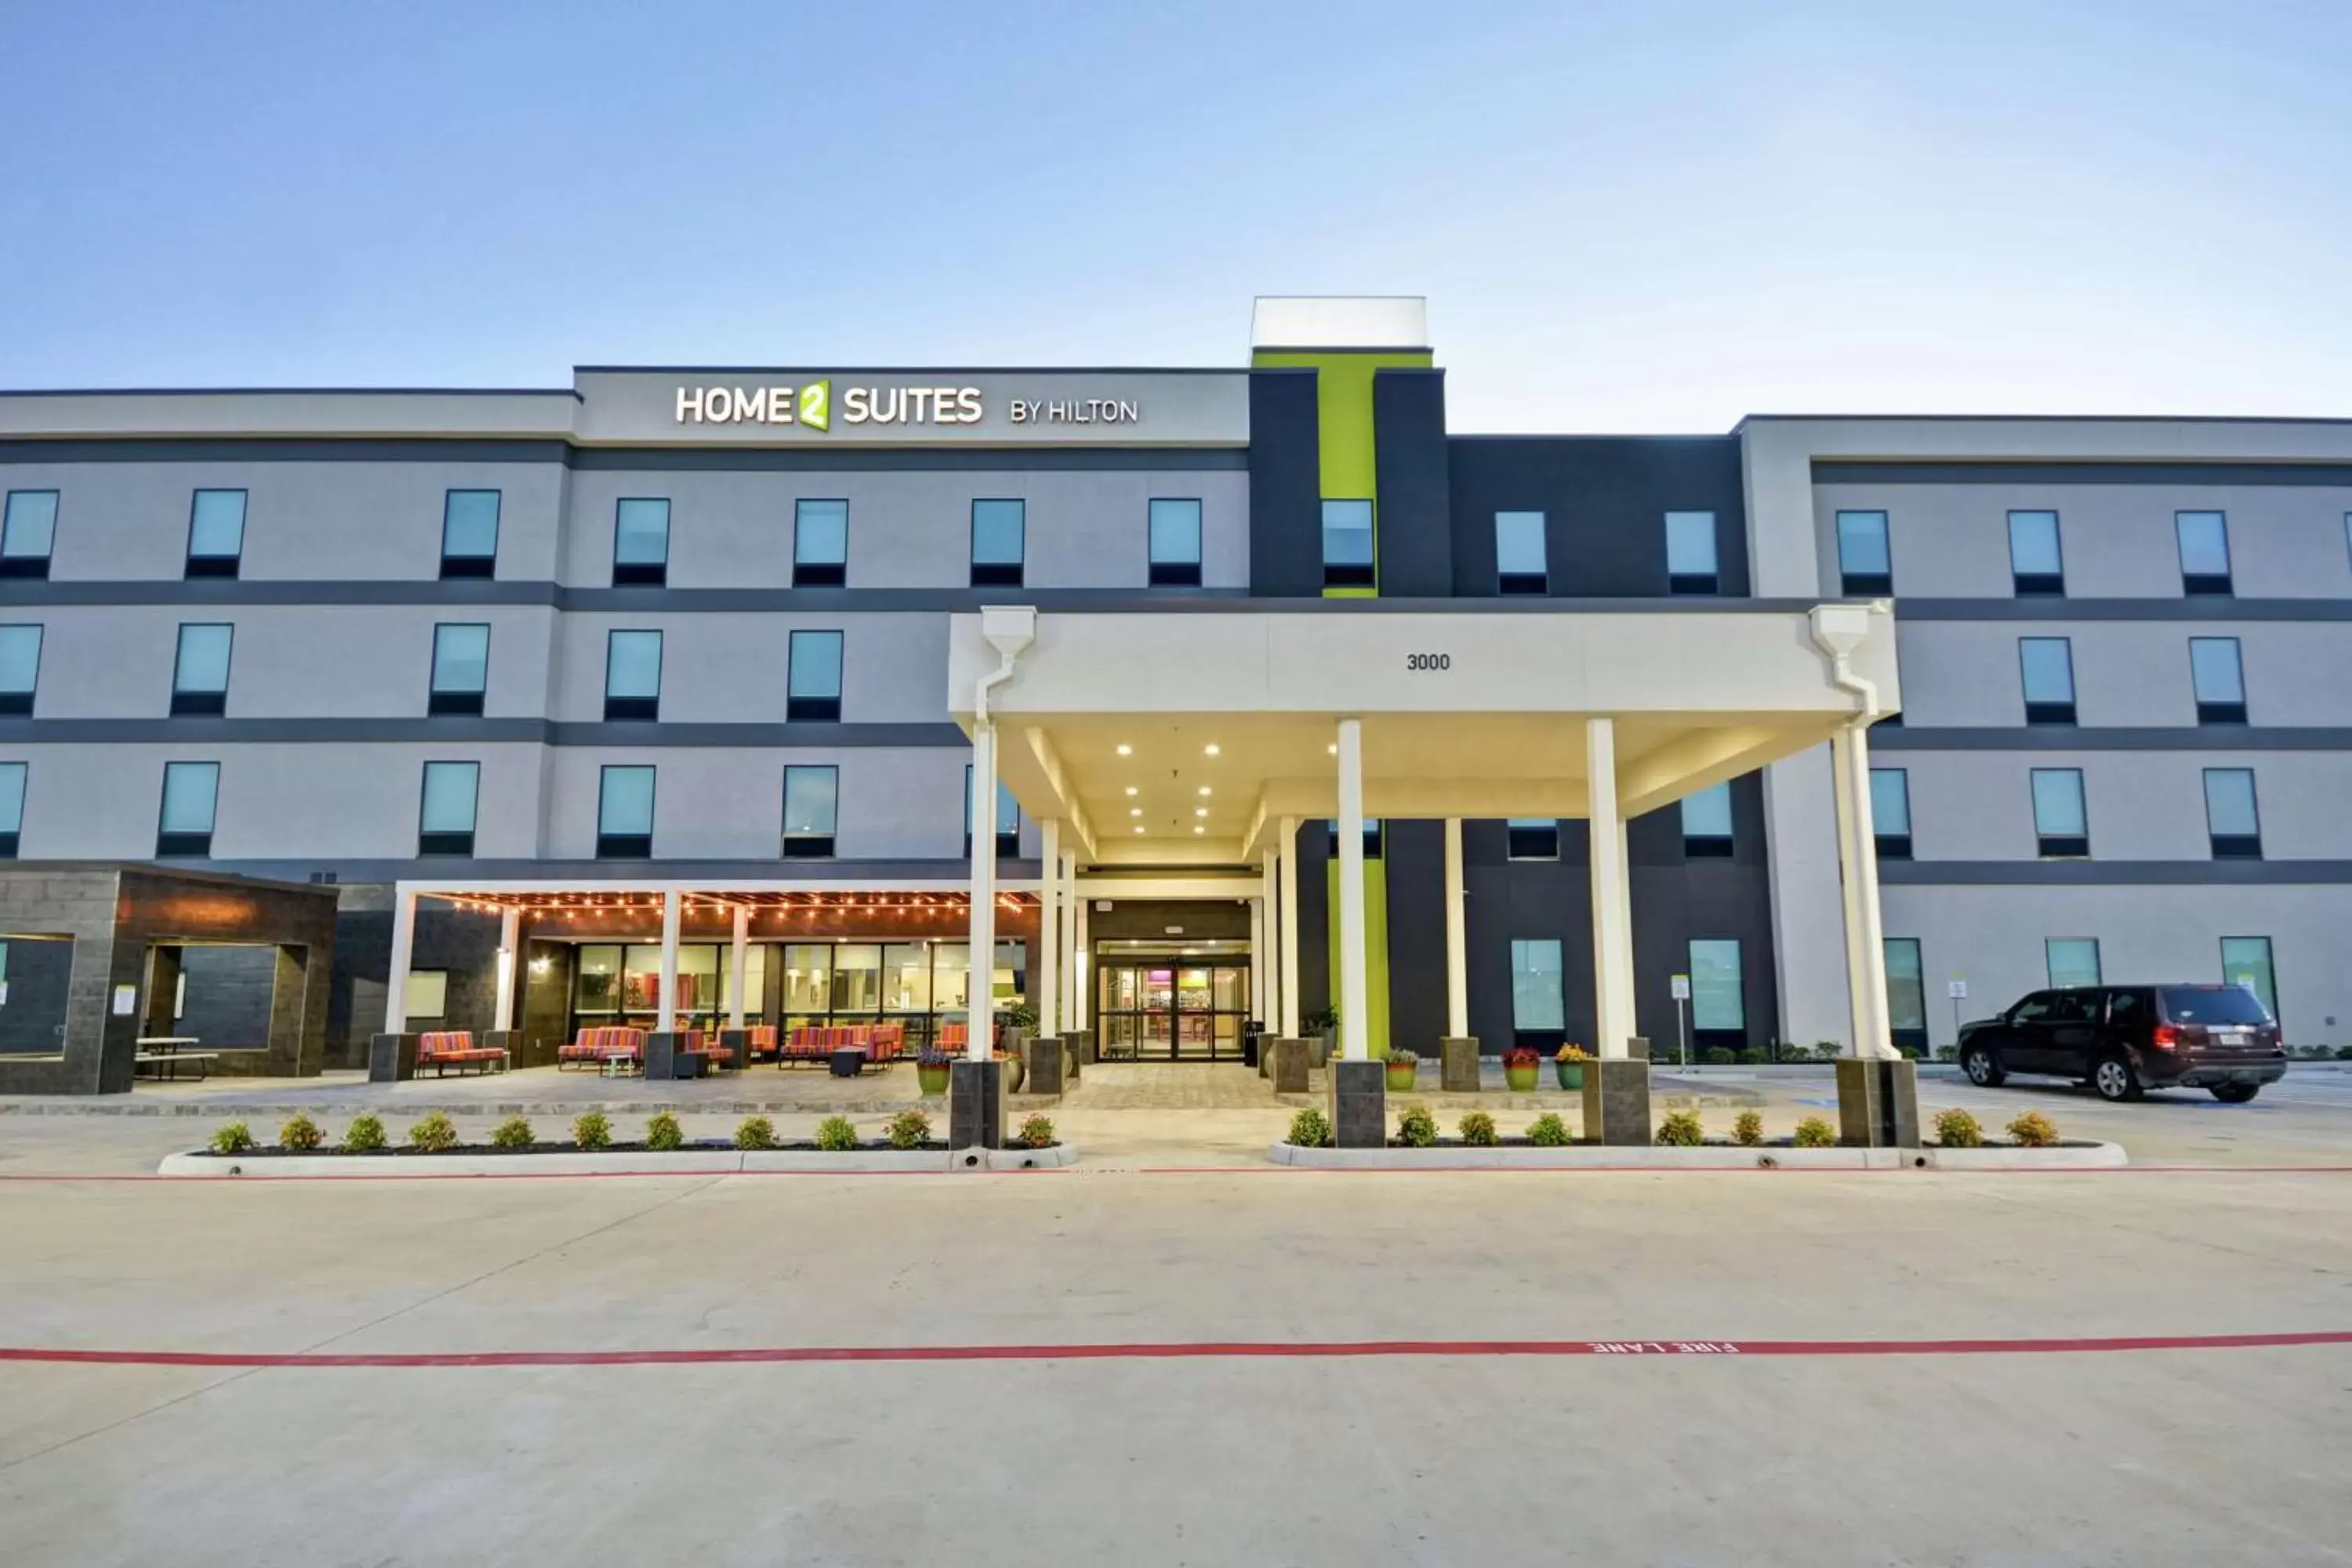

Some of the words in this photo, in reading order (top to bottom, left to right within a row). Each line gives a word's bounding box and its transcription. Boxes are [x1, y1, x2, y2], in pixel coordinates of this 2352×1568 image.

[676, 387, 794, 423] HOME
[801, 384, 826, 426] 2
[843, 387, 983, 424] SUITES
[1010, 399, 1042, 423] BY
[1048, 399, 1138, 423] HILTON
[1406, 652, 1450, 670] 3000
[1585, 1342, 1666, 1353] LANE
[1671, 1342, 1740, 1353] FIRE
